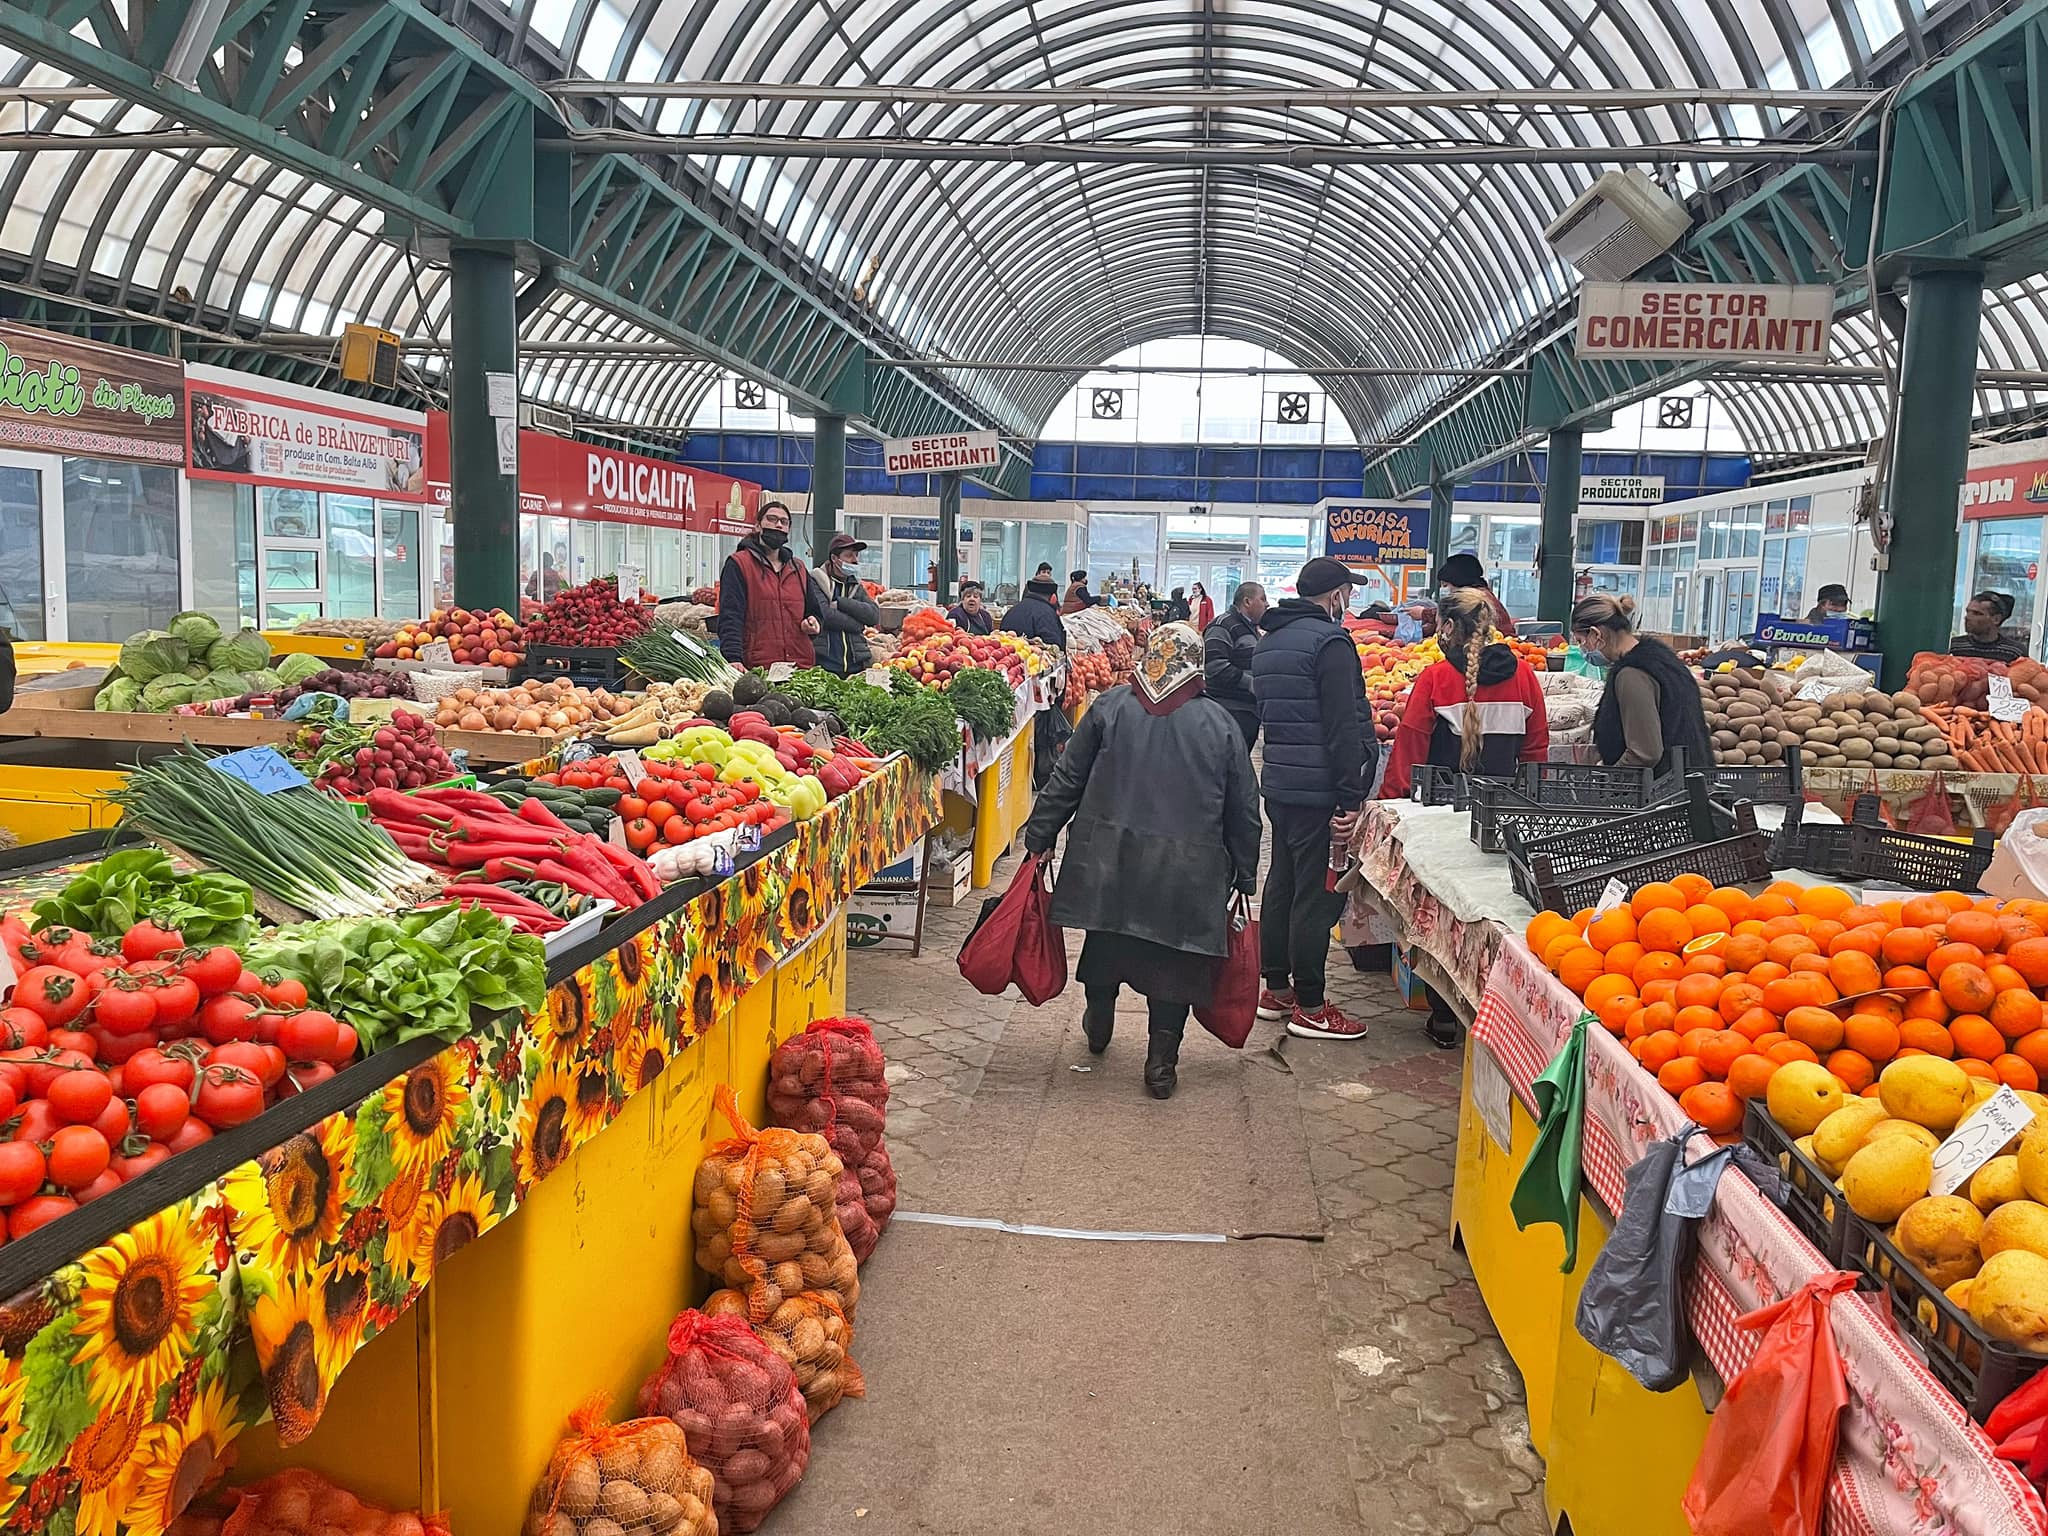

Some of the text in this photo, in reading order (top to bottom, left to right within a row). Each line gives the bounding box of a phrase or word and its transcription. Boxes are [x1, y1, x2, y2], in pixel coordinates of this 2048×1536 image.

[1641, 293, 1767, 316] SECTOR
[1586, 315, 1822, 353] COMERCIANTI
[212, 405, 411, 461] FABRICA de BRÂNZETURI
[911, 436, 969, 451] SECTOR
[284, 447, 315, 461] produse
[324, 453, 342, 465] Com.
[343, 455, 361, 468] Balta
[888, 447, 996, 472] COMERCIANTI
[587, 453, 697, 512] POLICALITA
[1581, 487, 1661, 499] PRODUCATORI
[1600, 478, 1642, 487] SECTOR
[521, 498, 544, 511] CARNE
